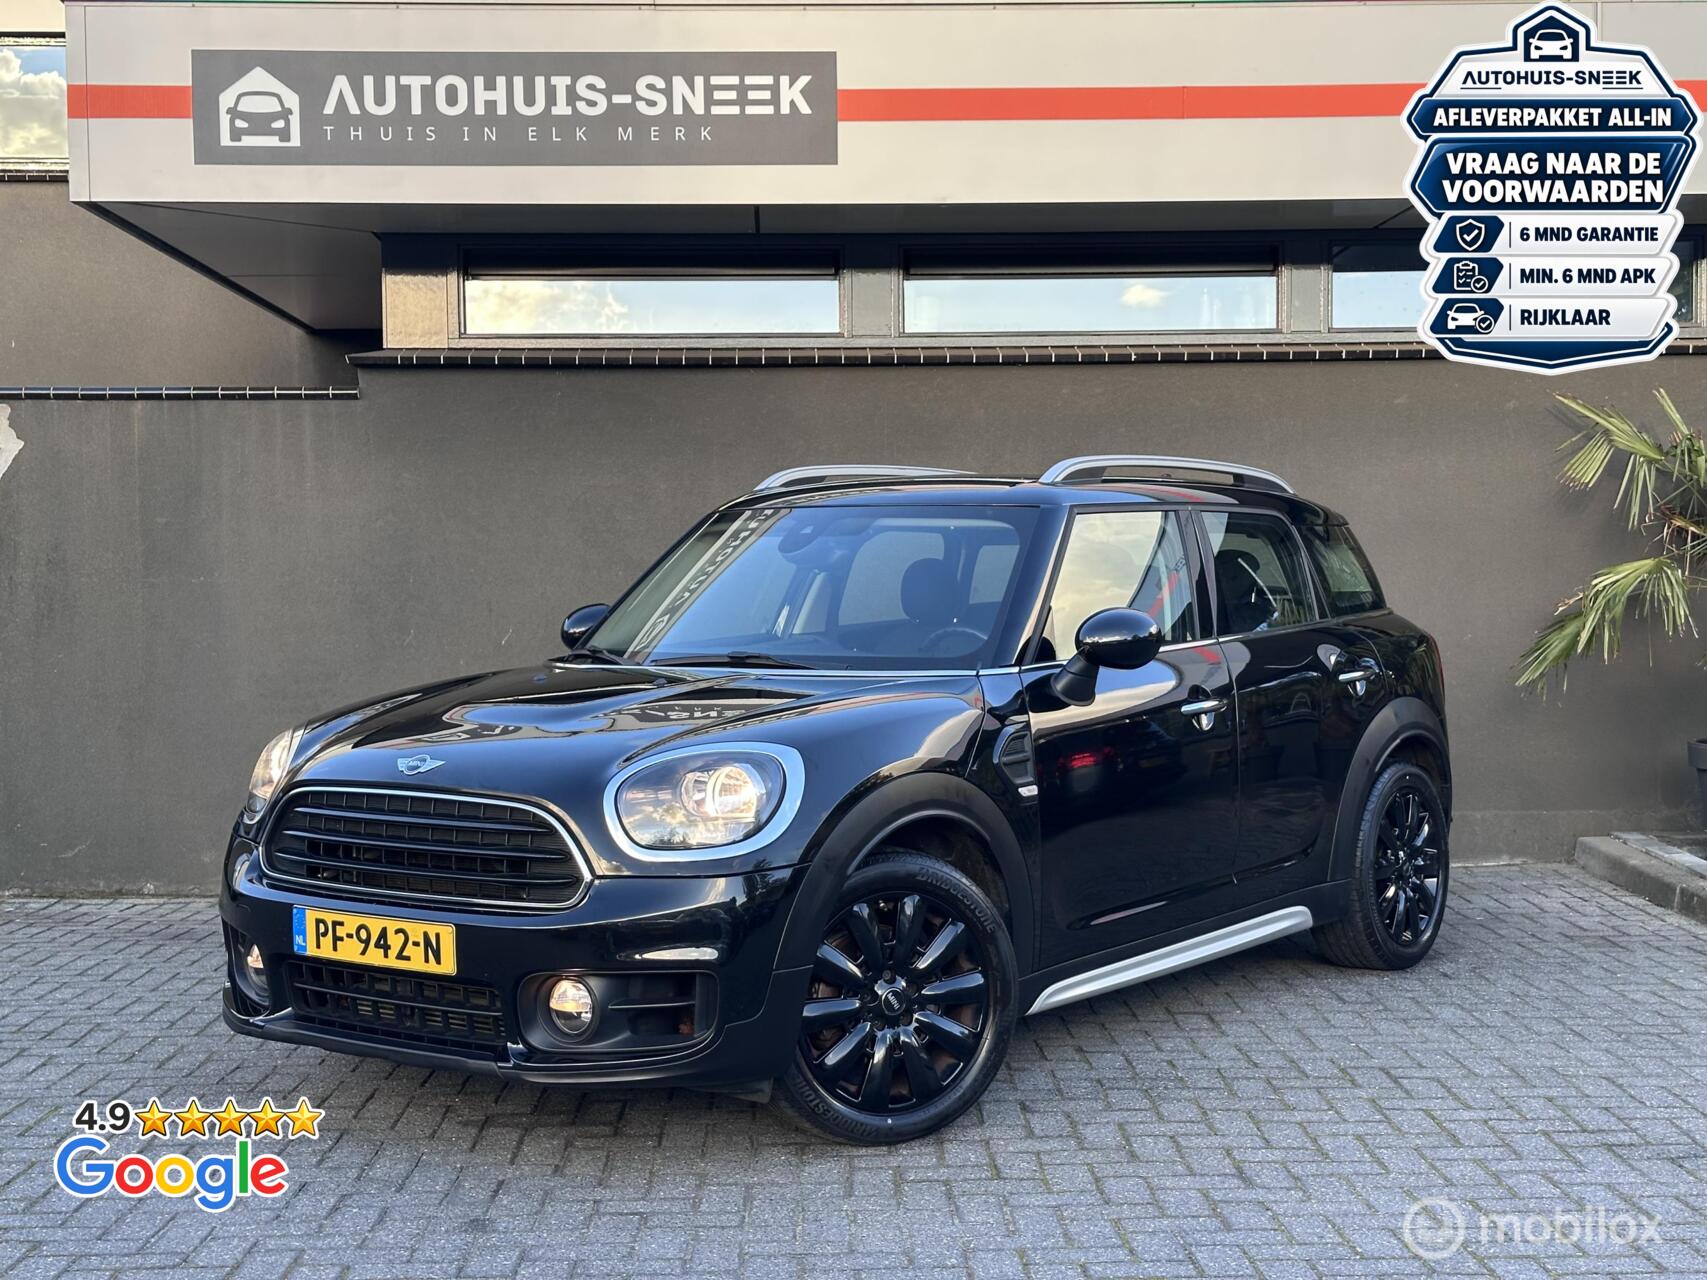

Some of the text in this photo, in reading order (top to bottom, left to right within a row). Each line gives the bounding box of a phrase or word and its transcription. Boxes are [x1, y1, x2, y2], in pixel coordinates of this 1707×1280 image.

[323, 74, 813, 116] AUTOHUIS-SNEEK
[323, 126, 712, 142] THUIS IN ELK MERK
[295, 934, 306, 946] NL
[315, 917, 442, 966] PF-942-N
[886, 992, 901, 1010] MINI
